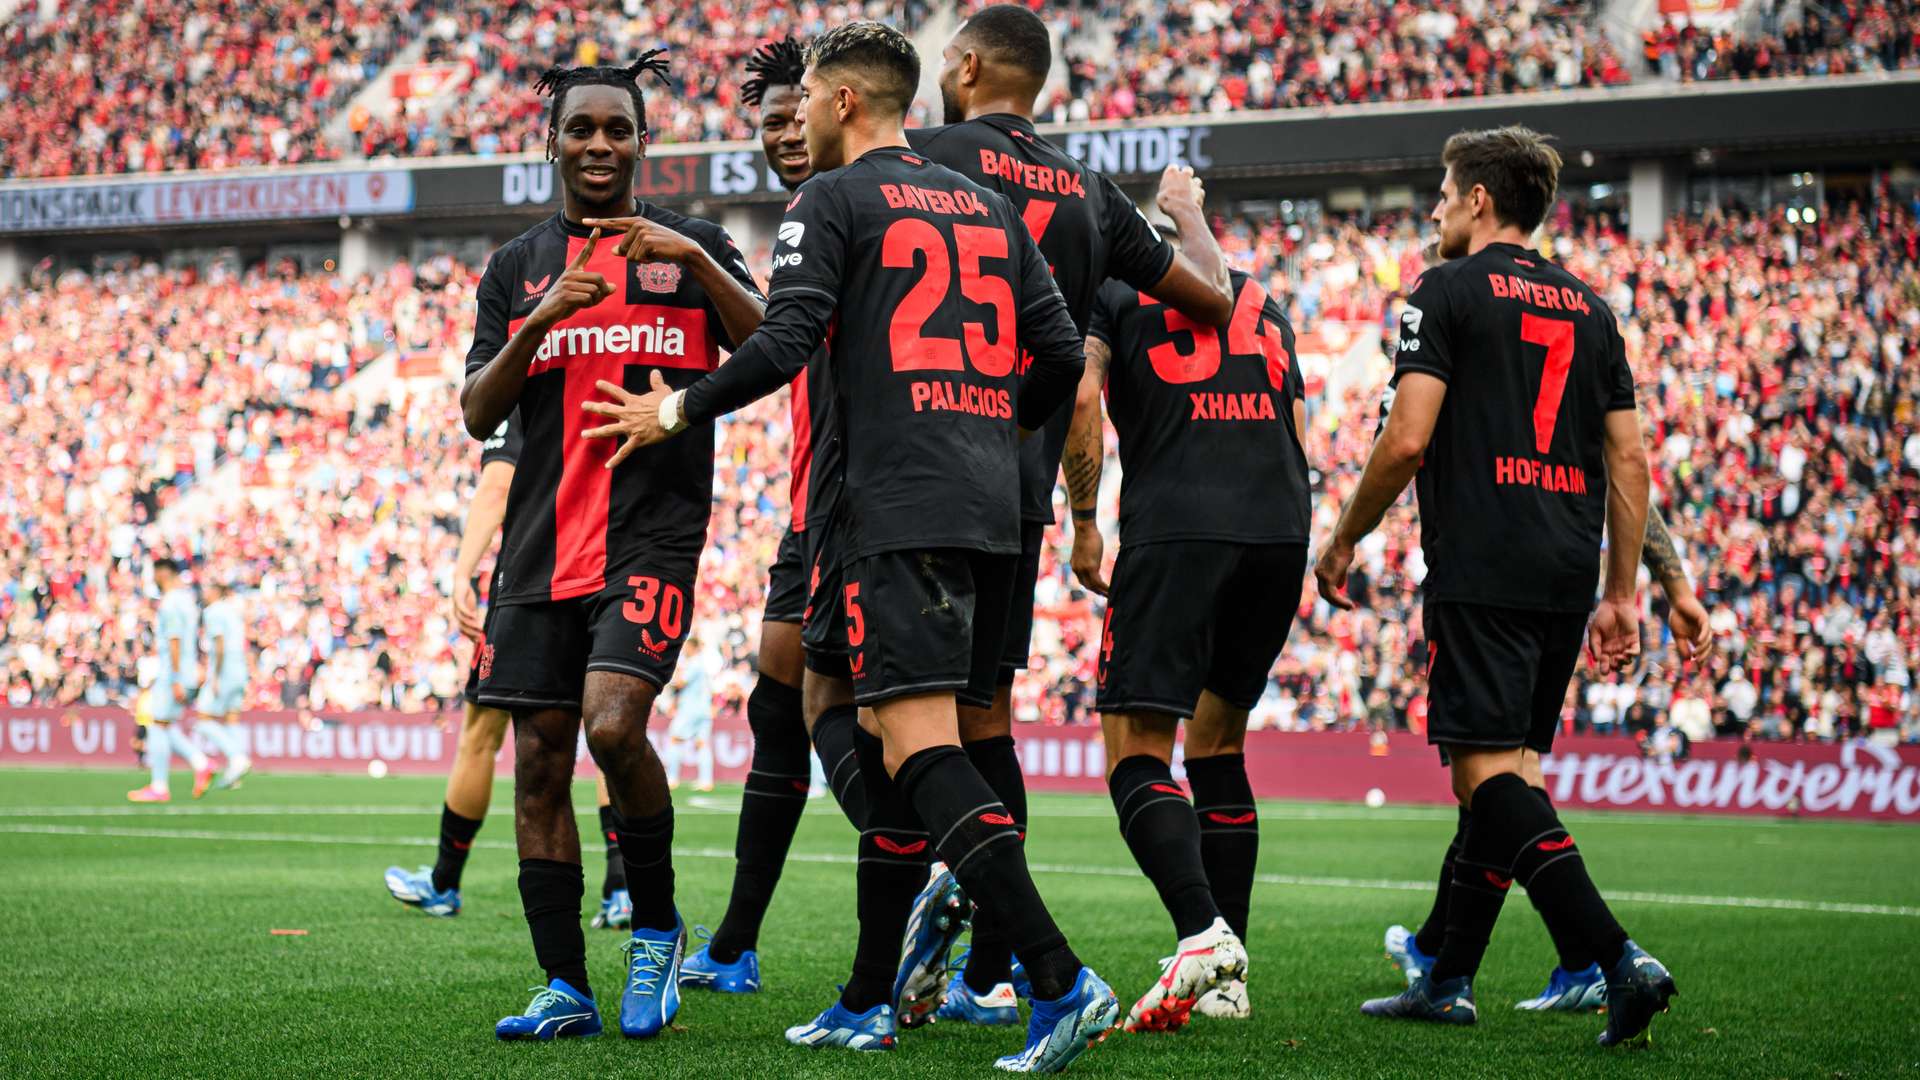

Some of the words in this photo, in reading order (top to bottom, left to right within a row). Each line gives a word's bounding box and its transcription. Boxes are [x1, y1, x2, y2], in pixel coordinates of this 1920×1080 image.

[154, 175, 349, 220] LEVERKUSEN
[503, 164, 552, 204] DU
[709, 152, 758, 194] ES
[980, 149, 1055, 193] BAYER
[1056, 169, 1086, 199] 04
[880, 184, 960, 214] BAYER
[954, 190, 989, 217] 04
[882, 218, 1017, 377] 25
[1488, 274, 1563, 310] BAYER
[1561, 287, 1591, 316] 04
[531, 317, 685, 363] armenia
[911, 381, 1012, 420] PALACIOS
[1190, 393, 1276, 420] XHAKA
[1520, 312, 1575, 454] 7
[1496, 456, 1587, 496] HOFMANN
[622, 576, 684, 639] 30
[845, 582, 865, 647] 5
[1102, 607, 1114, 662] 4
